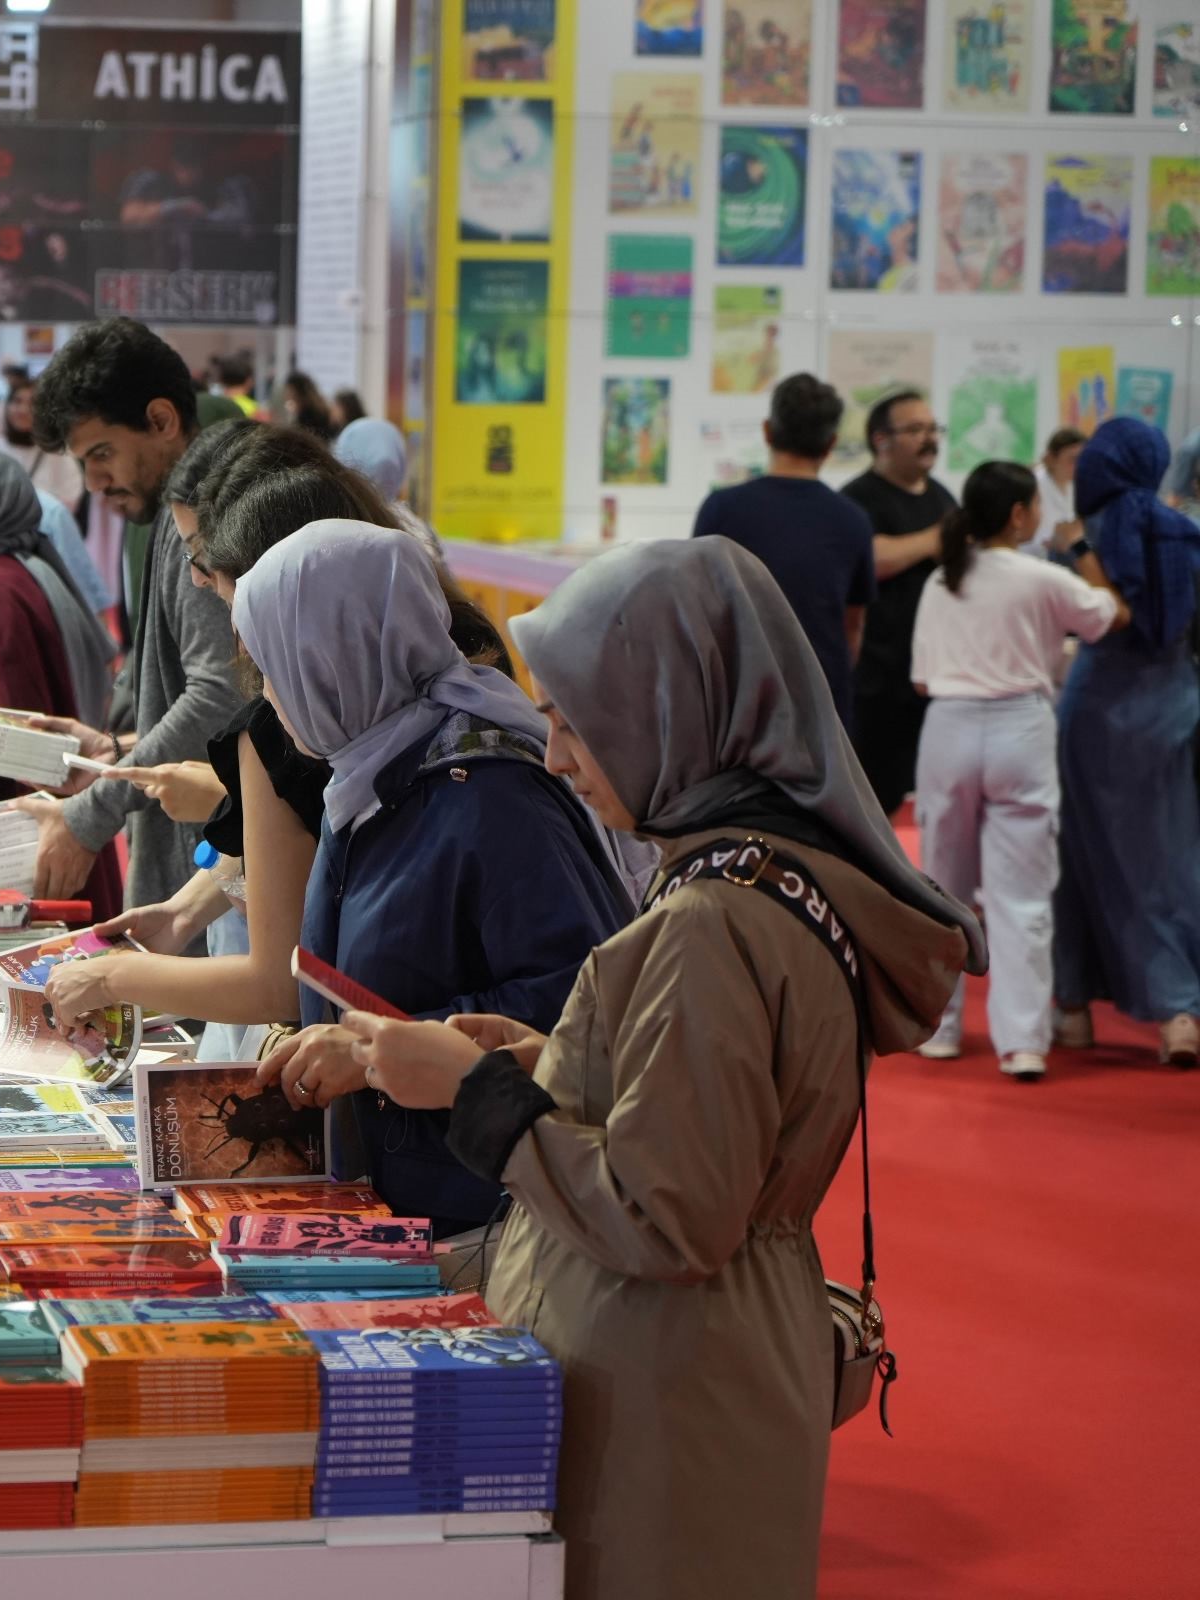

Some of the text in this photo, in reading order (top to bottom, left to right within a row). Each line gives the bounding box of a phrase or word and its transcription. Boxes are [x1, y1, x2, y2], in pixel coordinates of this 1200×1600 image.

[94, 44, 288, 102] ATHİCA
[650, 846, 859, 978] MARC JACO
[154, 1106, 165, 1177] FRANZ KAFKA
[164, 1097, 181, 1176] DÖNÜŞÜM
